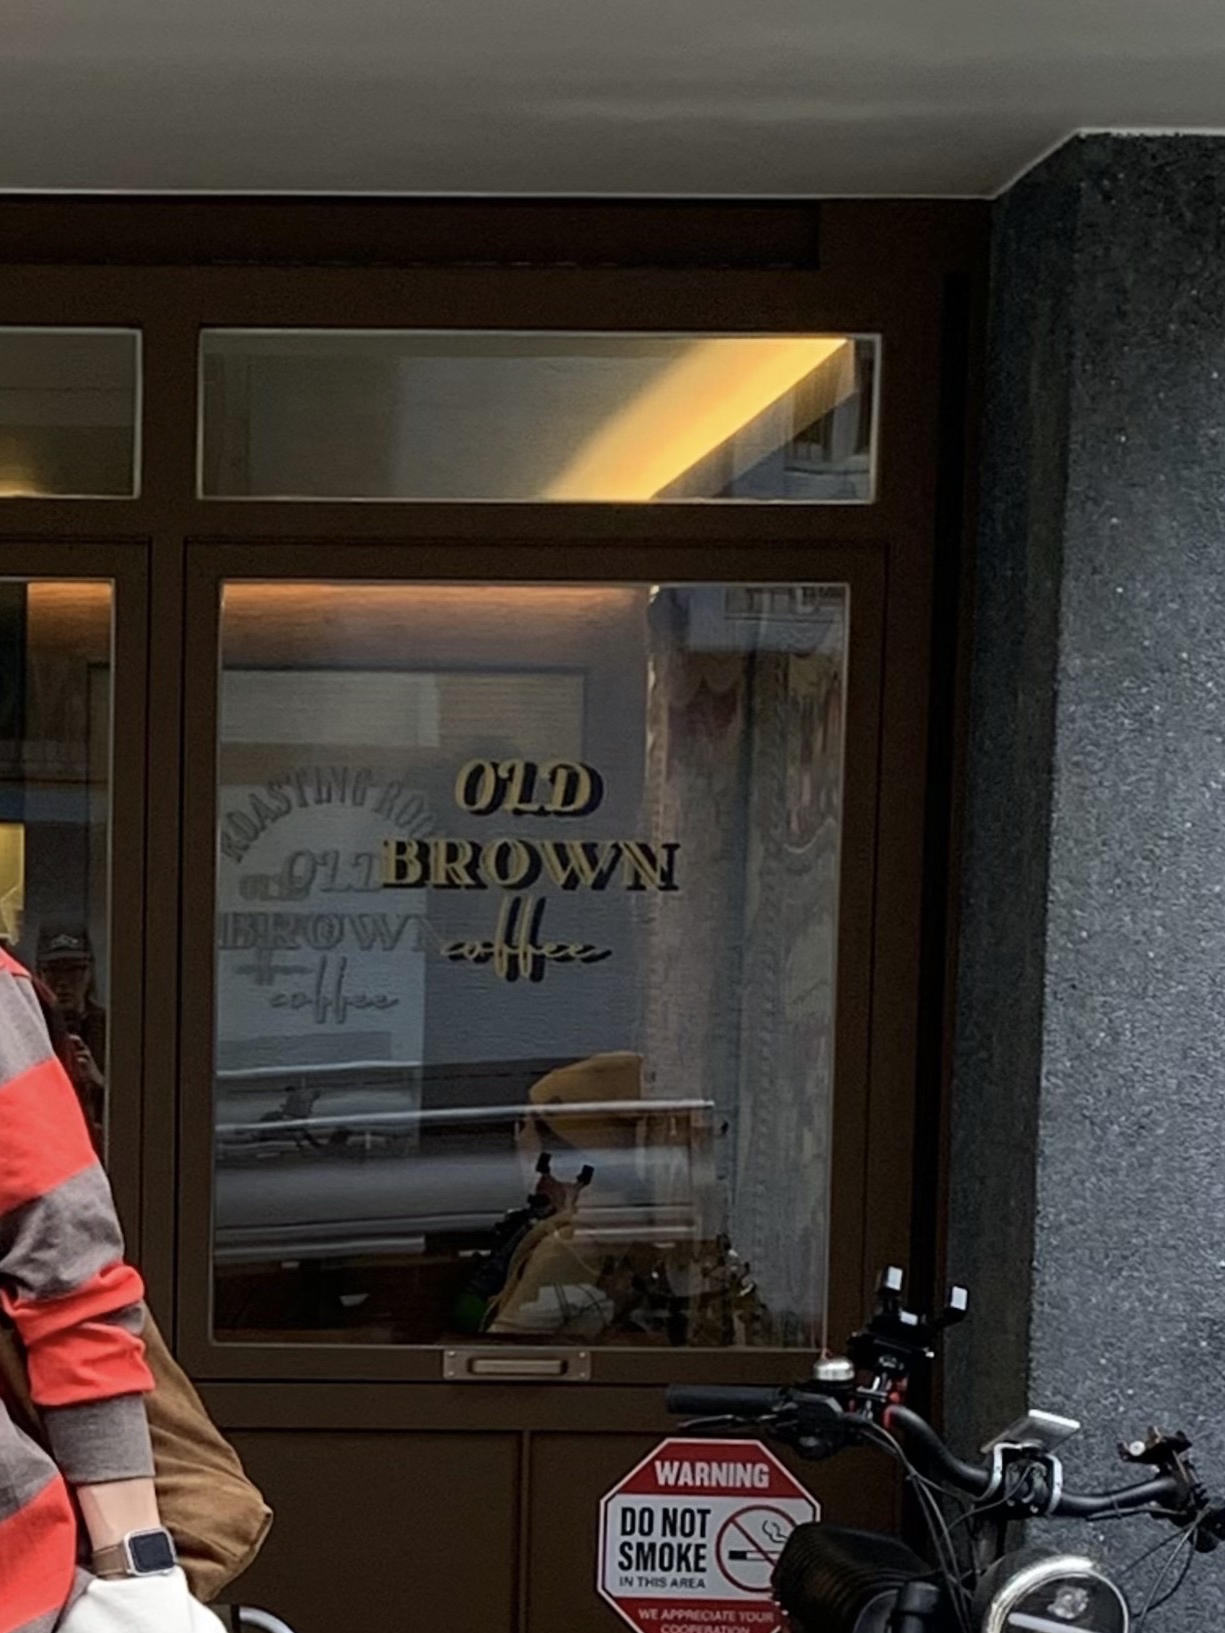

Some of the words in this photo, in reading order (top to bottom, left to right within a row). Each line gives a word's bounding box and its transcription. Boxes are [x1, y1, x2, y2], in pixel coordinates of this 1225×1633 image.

[455, 759, 604, 816] OLD
[383, 838, 681, 890] BROWN
[440, 895, 612, 983] coffee
[269, 955, 400, 1025] coffee
[654, 1460, 769, 1488] WARNING
[620, 1507, 654, 1536] DO
[661, 1508, 711, 1538] NOT
[618, 1541, 707, 1573] SMOKE
[619, 1576, 633, 1587] IN
[638, 1576, 667, 1588] THIS
[671, 1577, 706, 1589] AREA
[638, 1608, 658, 1620] WE
[660, 1609, 736, 1622] APPRECIATE
[739, 1611, 774, 1622] YOUR
